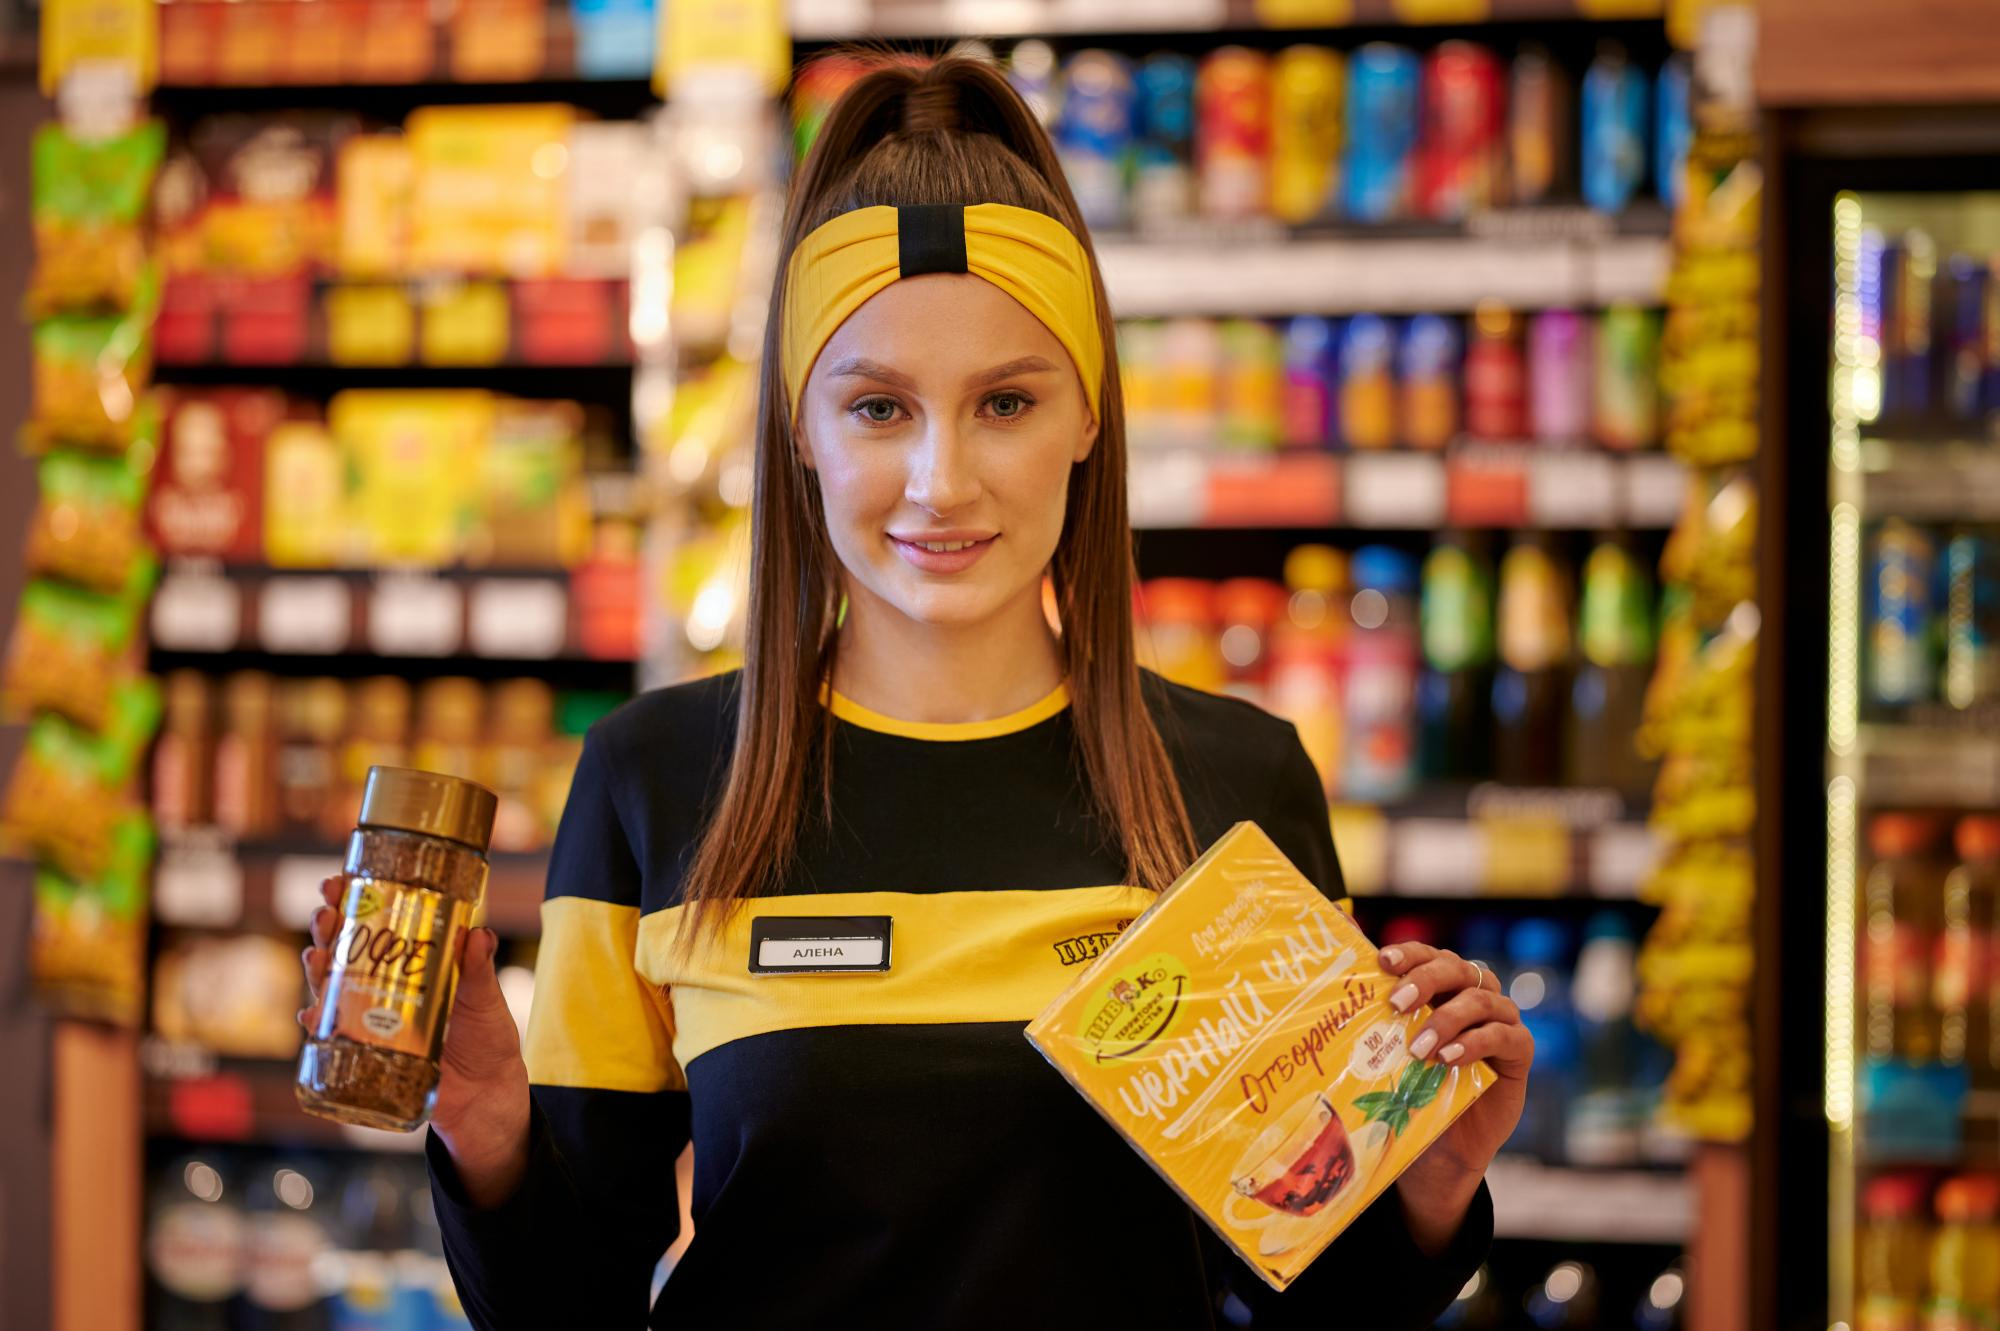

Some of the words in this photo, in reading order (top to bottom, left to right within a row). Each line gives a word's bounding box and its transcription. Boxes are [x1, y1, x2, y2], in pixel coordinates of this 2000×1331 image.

[335, 923, 436, 977] ОФЕ
[793, 947, 844, 958] АЛЕНА
[1261, 905, 1343, 985] ЧАЙ
[1114, 991, 1164, 1041] ТЕРРИТОРИЯ
[1127, 1005, 1164, 1041] СЧАСТЬЯ
[1364, 1031, 1383, 1052] 100
